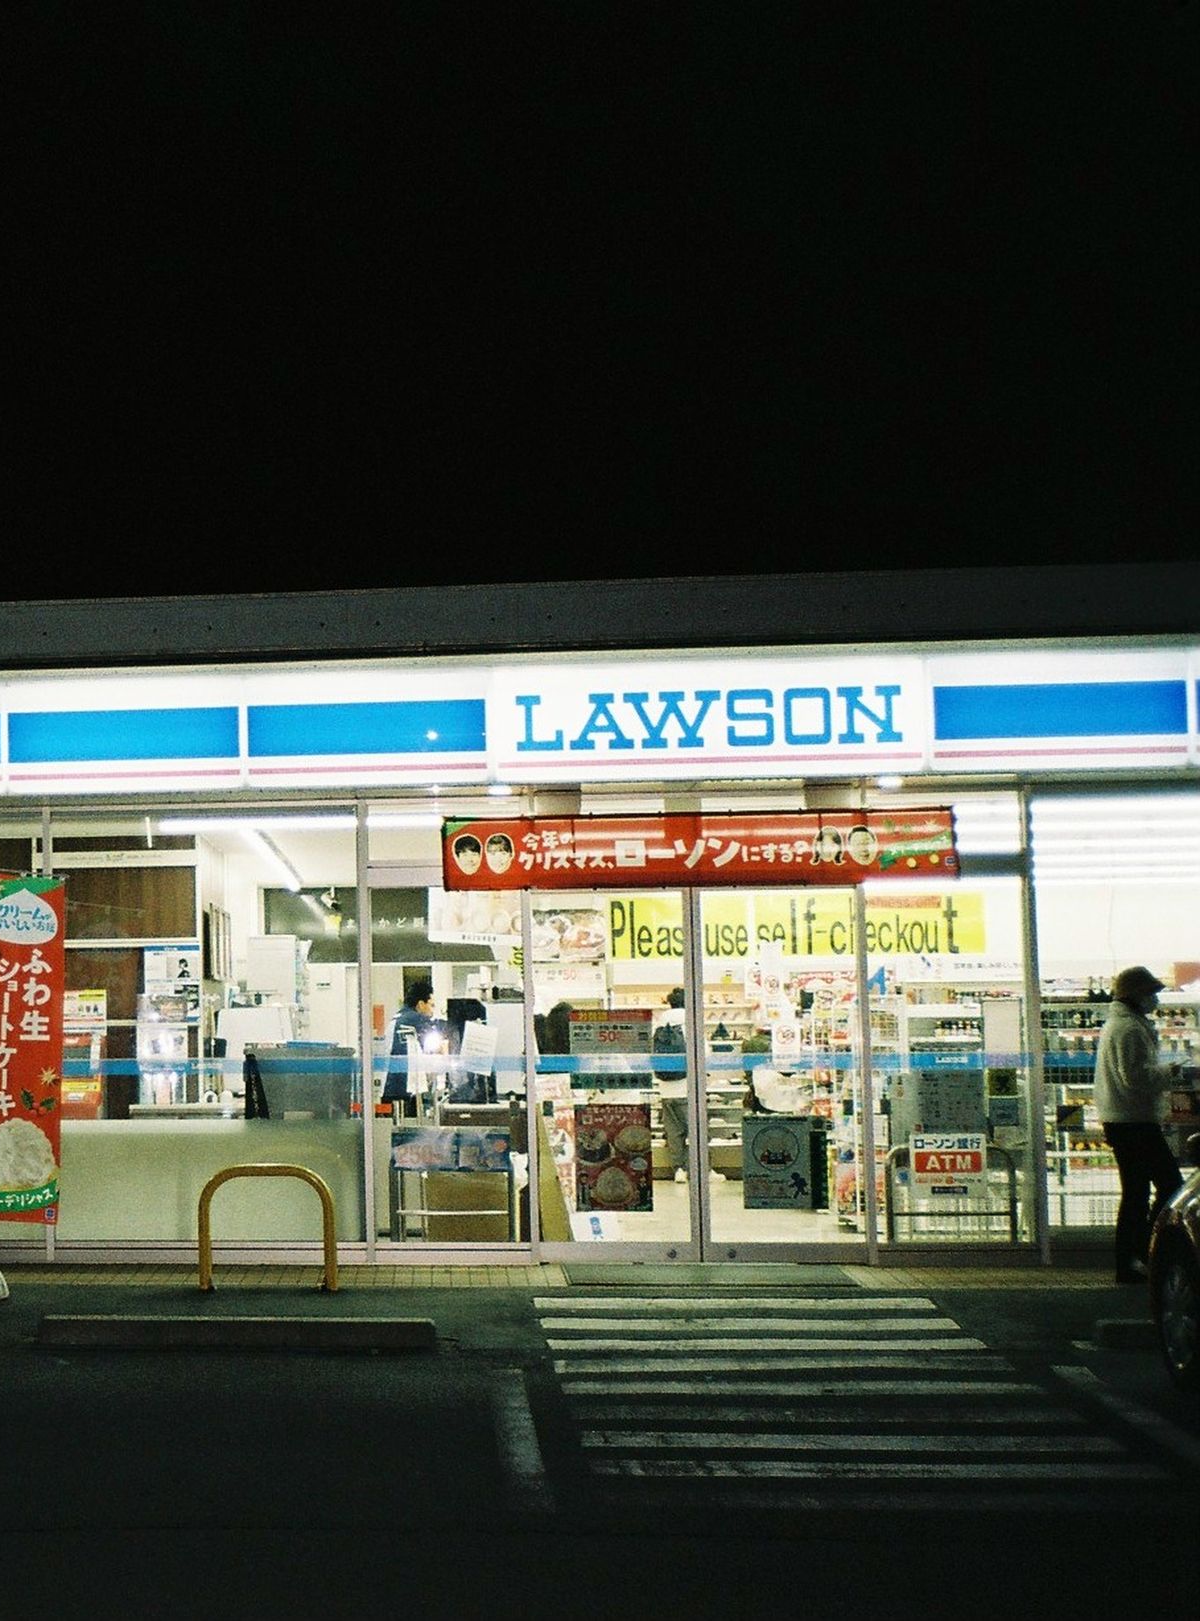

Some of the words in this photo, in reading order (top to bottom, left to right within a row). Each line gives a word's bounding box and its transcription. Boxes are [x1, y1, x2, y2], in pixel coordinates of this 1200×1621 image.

[515, 684, 903, 752] LAWSON
[610, 900, 686, 958] Pleas
[705, 923, 748, 957] use
[19, 948, 53, 1041] ふわ生
[913, 1138, 982, 1150] ローソン銀行
[925, 1154, 973, 1171] ATM
